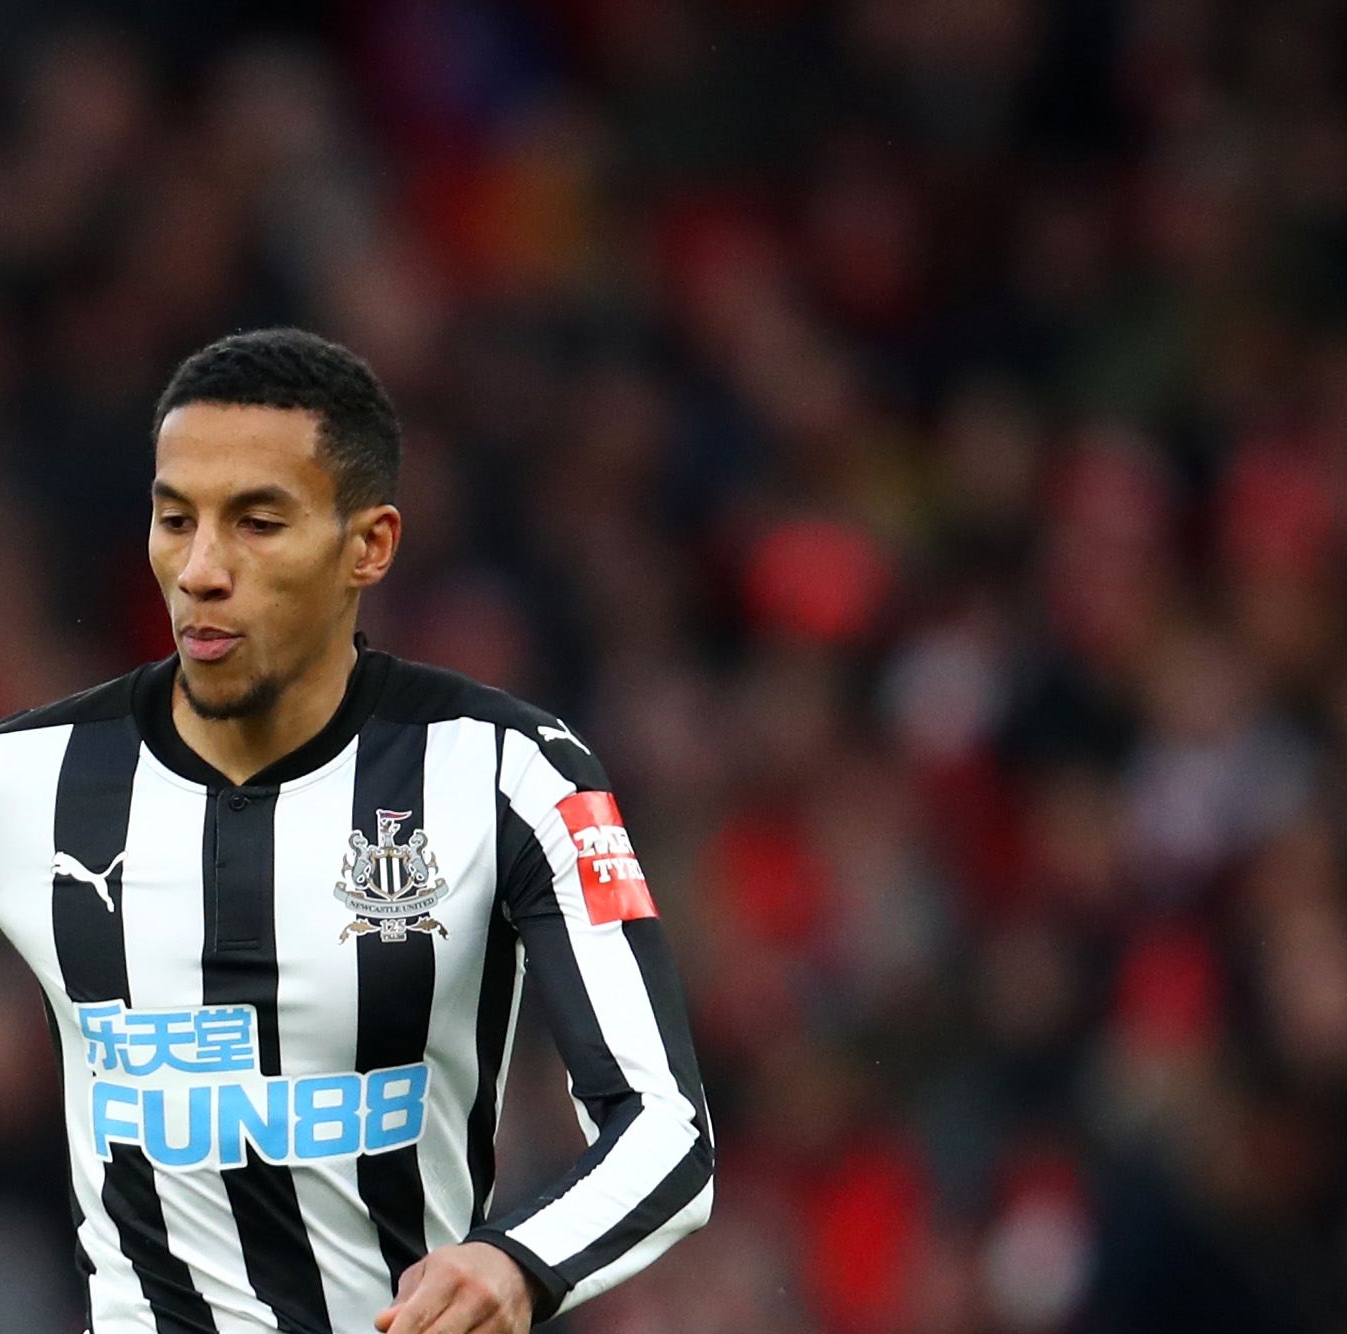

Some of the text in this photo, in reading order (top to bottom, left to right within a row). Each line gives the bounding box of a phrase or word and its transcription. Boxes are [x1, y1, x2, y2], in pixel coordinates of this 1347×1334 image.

[350, 897, 434, 914] NEWCASTLE UNITED
[78, 1003, 255, 1077] 乐天堂
[92, 1064, 428, 1166] FUN88
